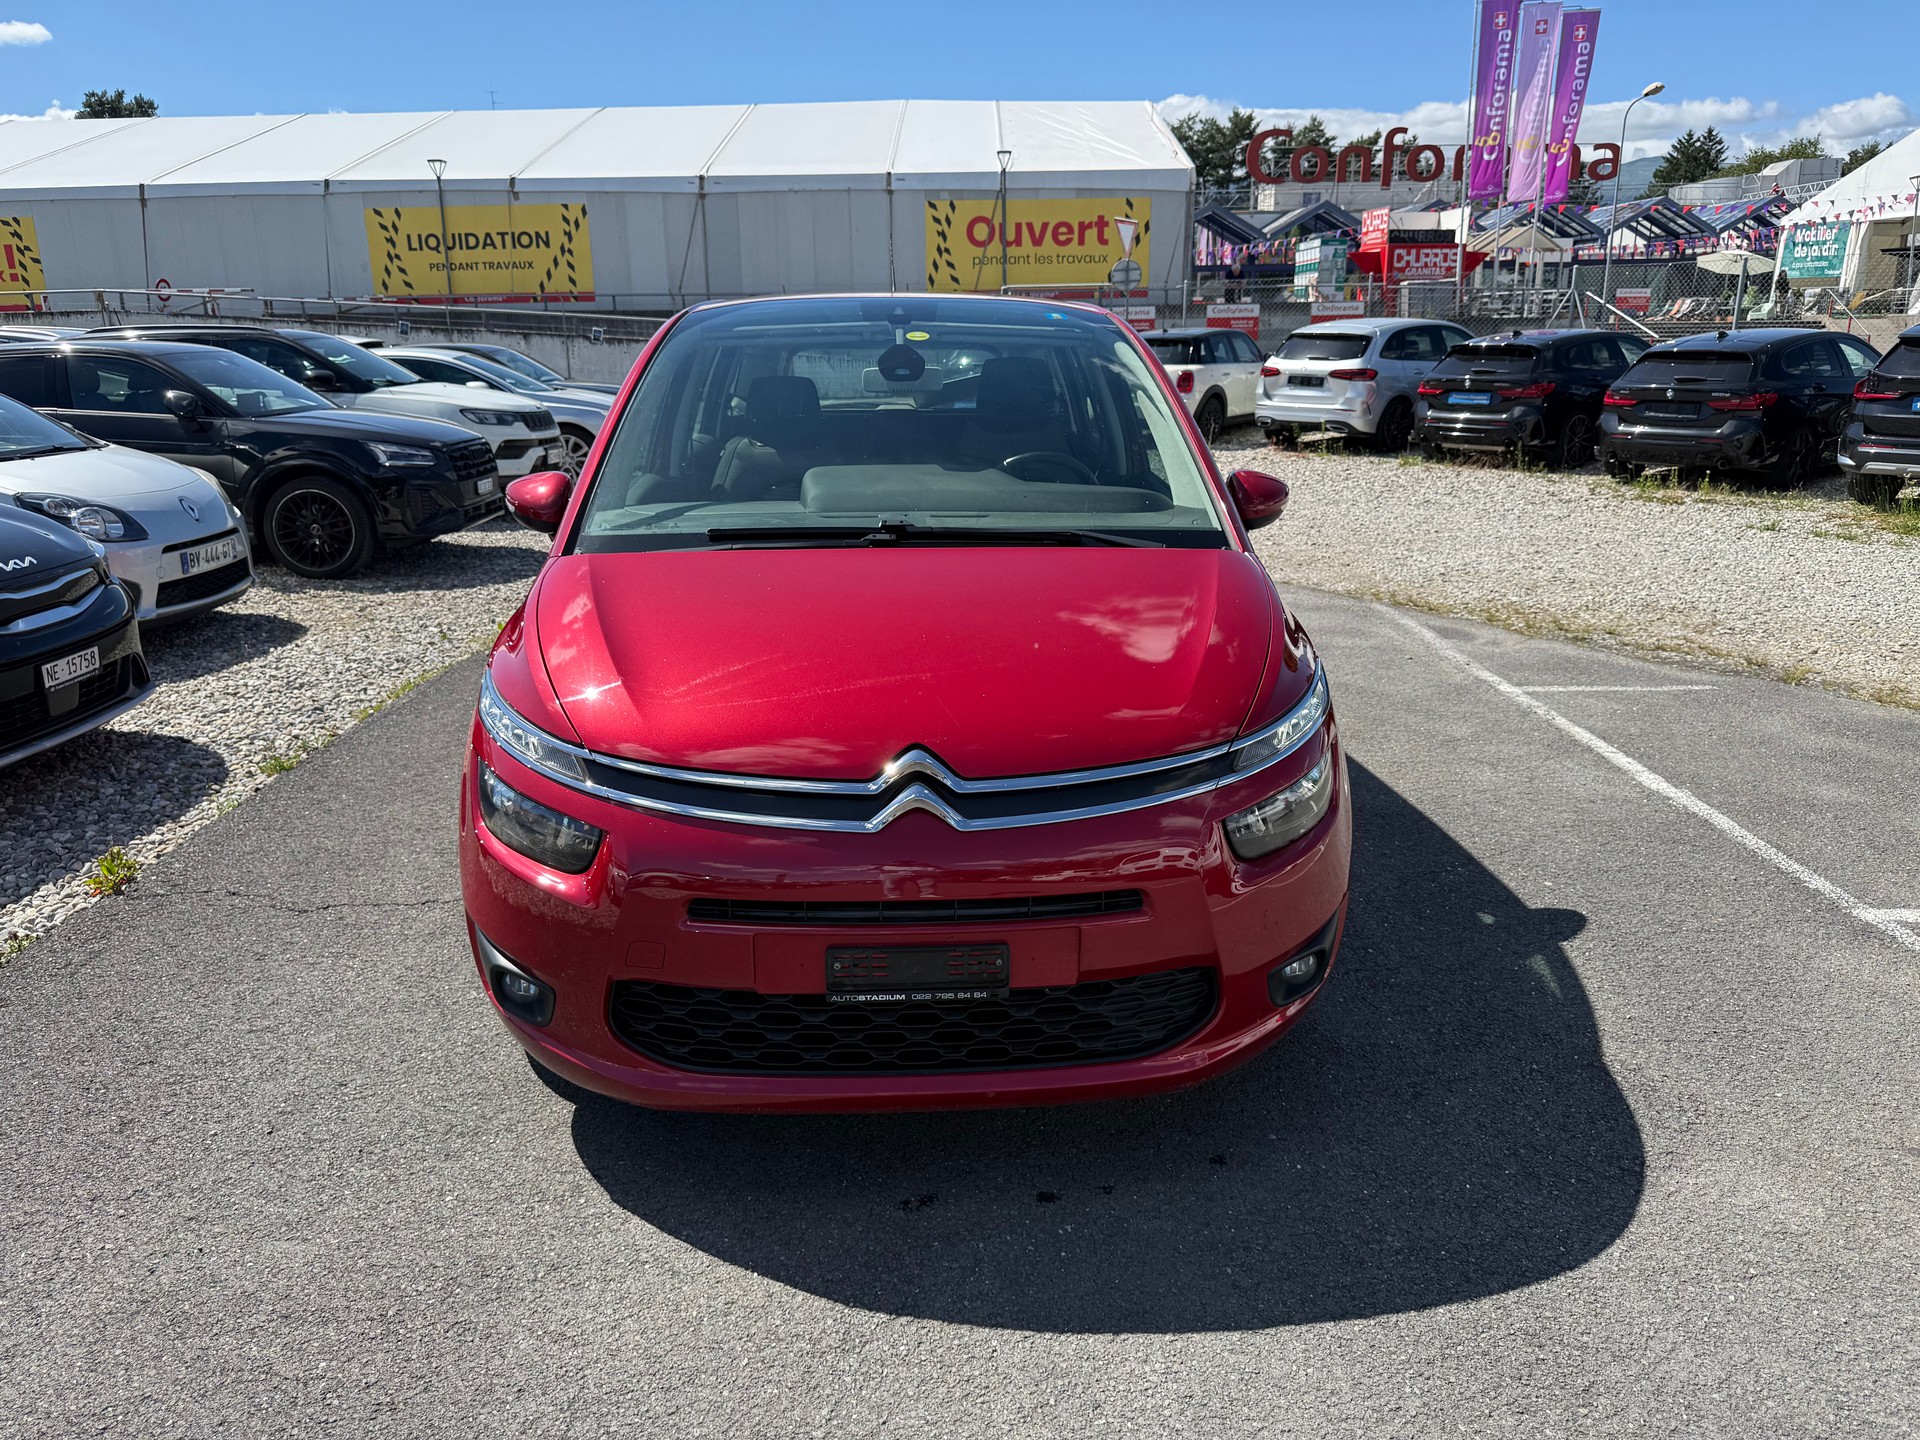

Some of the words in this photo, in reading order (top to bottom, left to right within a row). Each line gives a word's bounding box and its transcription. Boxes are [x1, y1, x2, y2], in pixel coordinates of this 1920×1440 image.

[1246, 127, 1621, 190] Confora
[966, 214, 1110, 248] Ouvert
[1795, 225, 1837, 243] Mobilier
[406, 230, 551, 254] LIQUIDATION
[1393, 248, 1458, 268] CHURROS
[1794, 243, 1807, 258] de
[1807, 240, 1839, 261] jardin
[429, 262, 480, 272] PENDANT
[482, 261, 534, 271] TRAVAUX
[1034, 253, 1053, 265] les
[1056, 253, 1109, 265] travaux
[1405, 268, 1446, 276] GRANITAS
[1212, 306, 1255, 315] Conforama
[1316, 304, 1359, 312] Conforama
[831, 994, 906, 1002] AUTOSTADIUM
